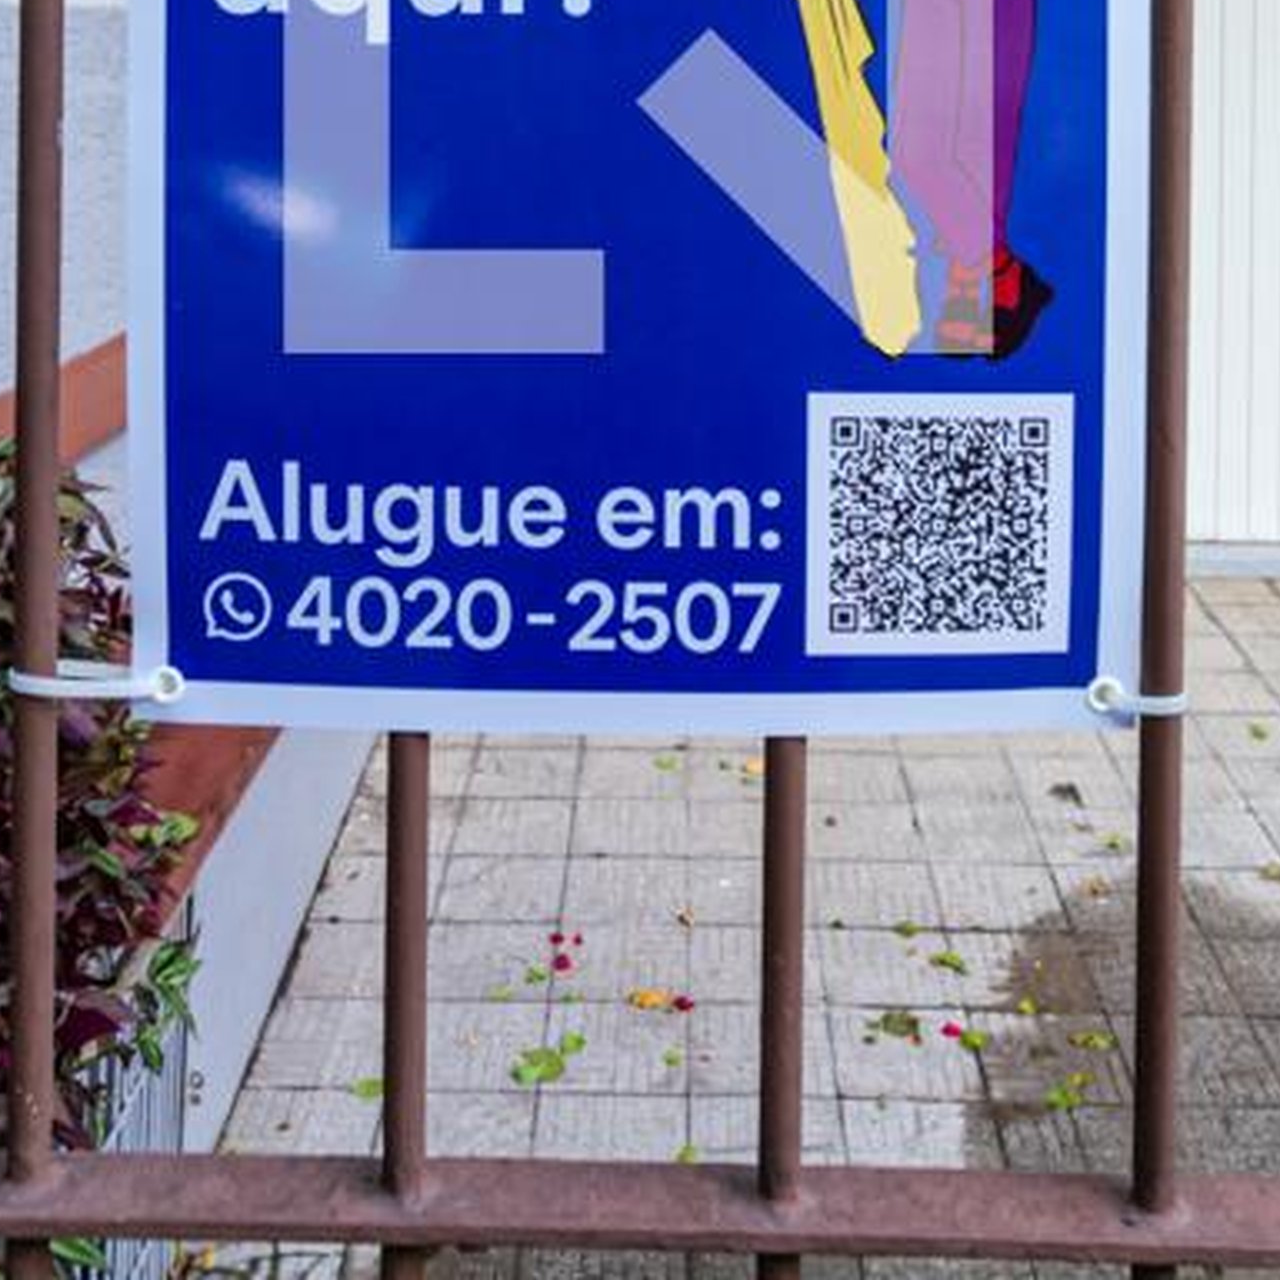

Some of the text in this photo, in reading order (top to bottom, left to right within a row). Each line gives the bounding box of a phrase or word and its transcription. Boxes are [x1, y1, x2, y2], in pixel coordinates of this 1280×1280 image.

[199, 459, 783, 567] Alugue em:
[286, 576, 782, 655] 4020-2507
